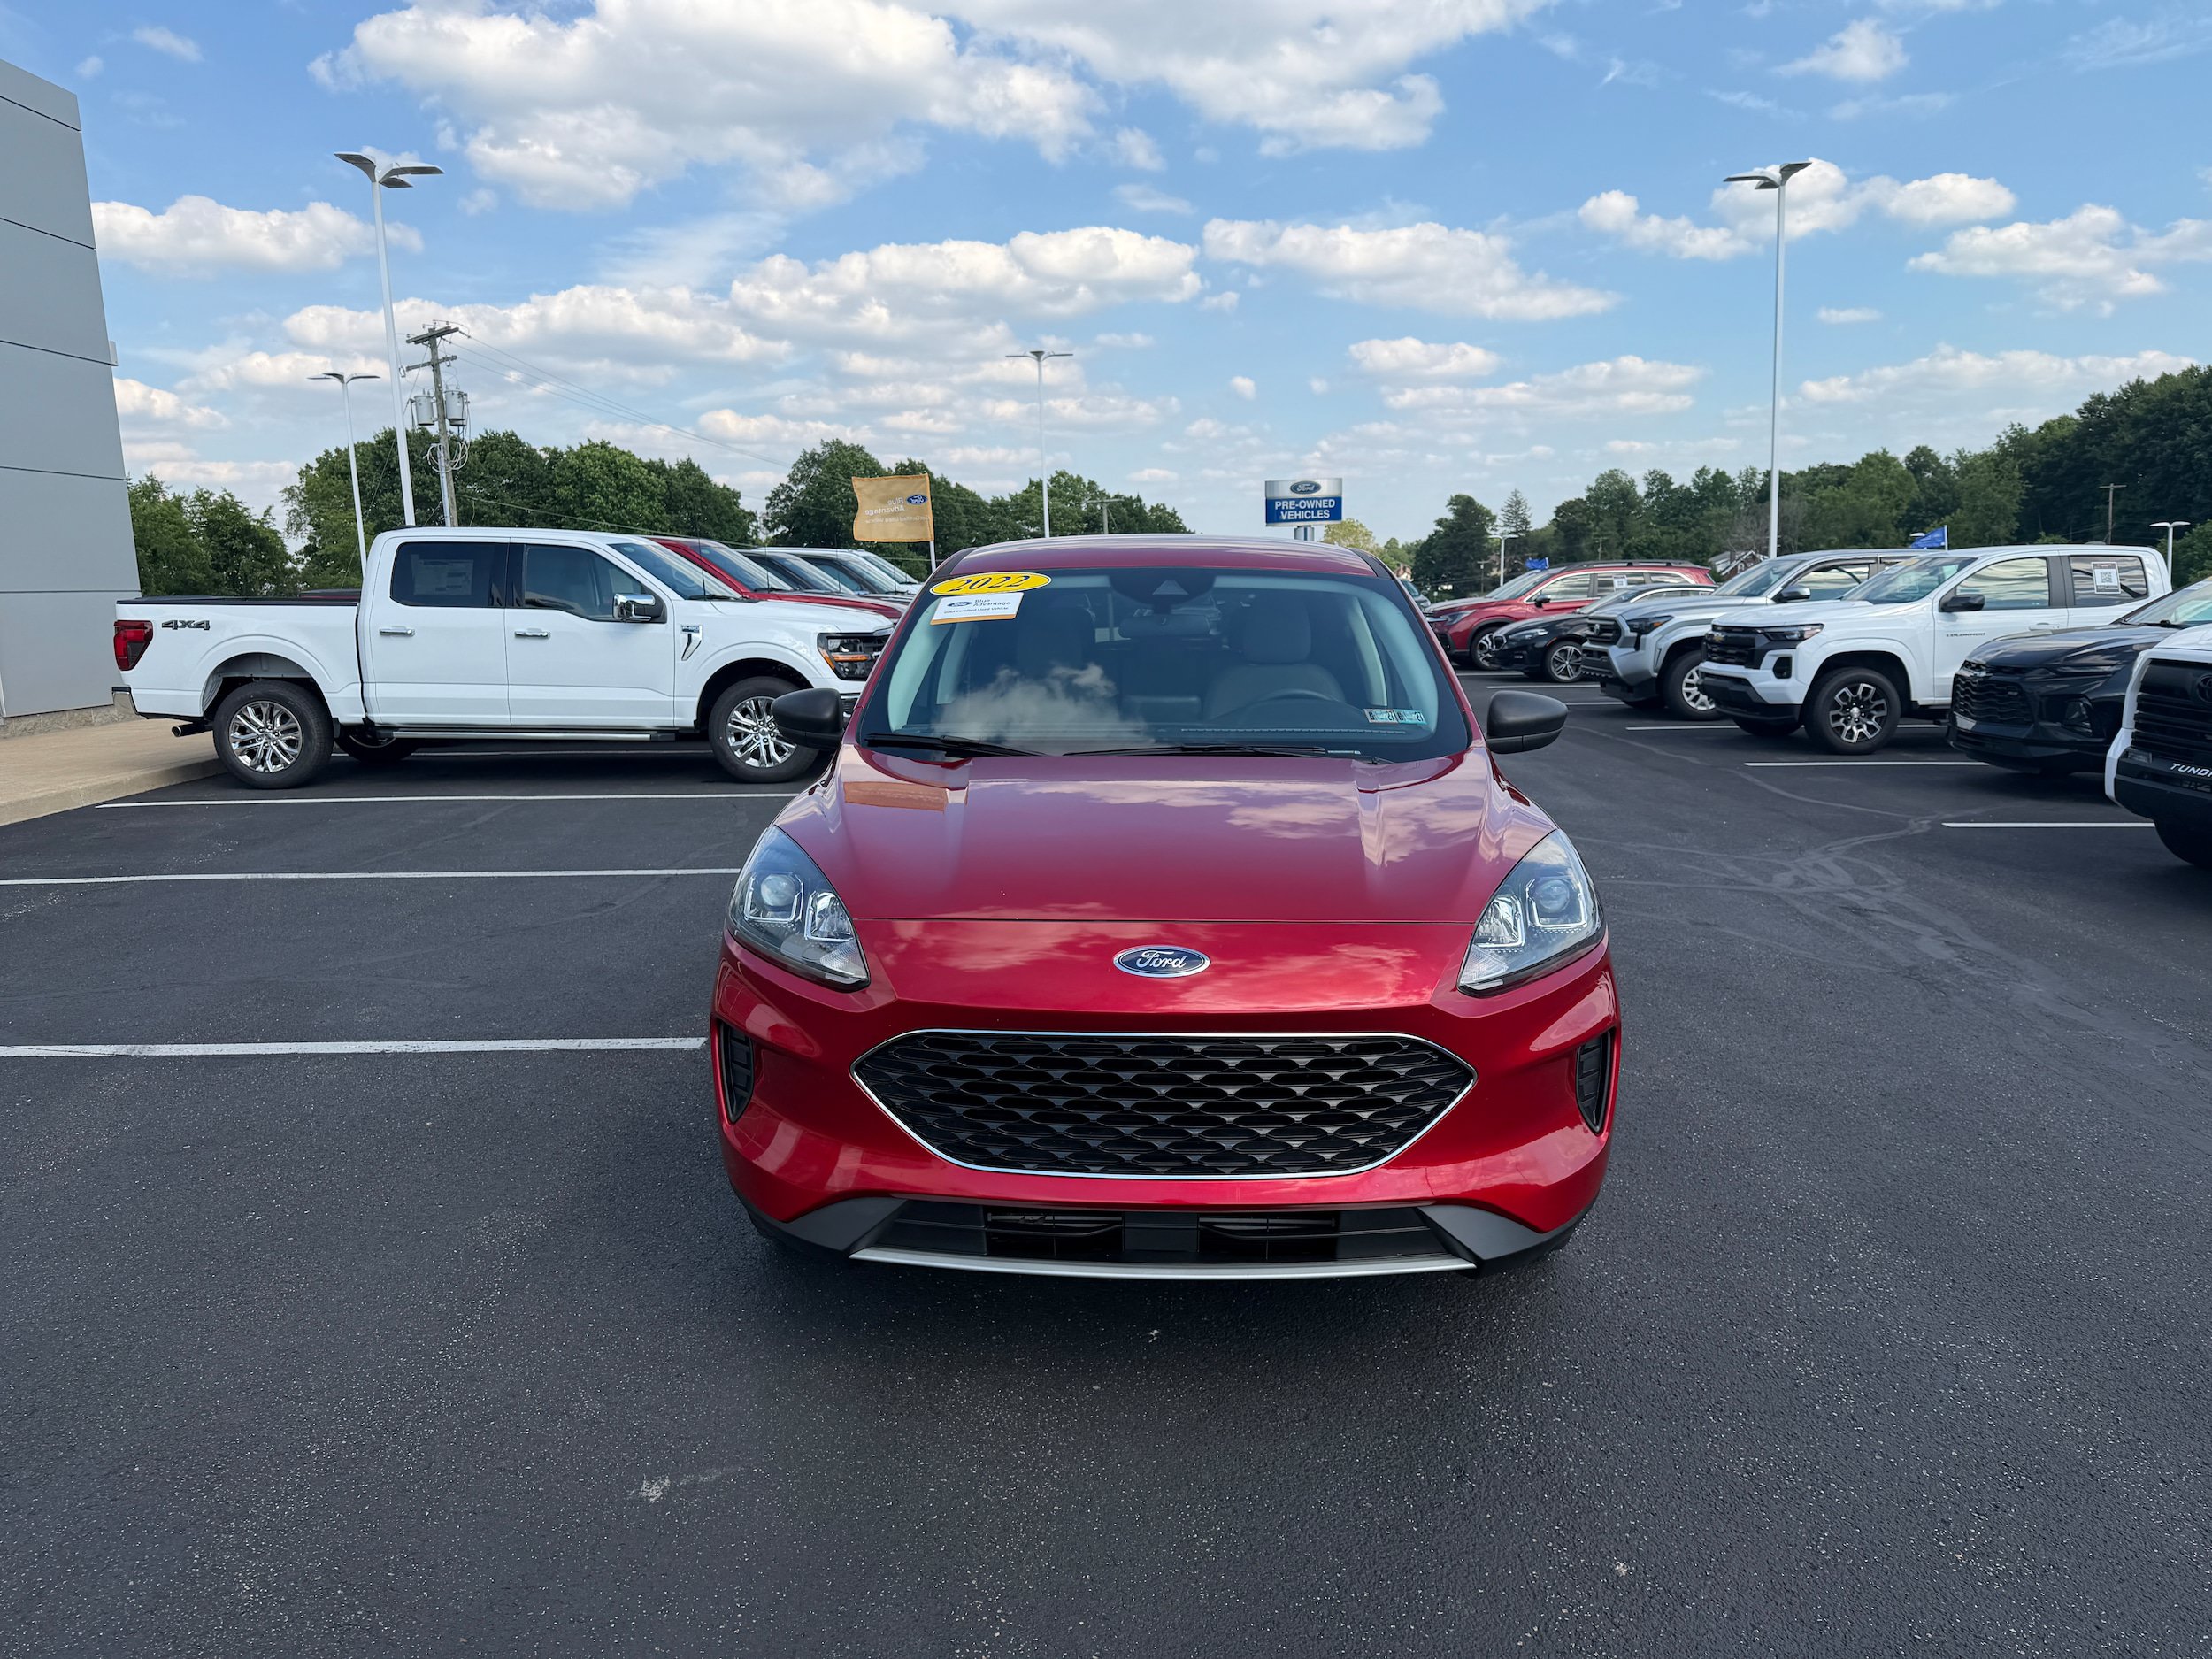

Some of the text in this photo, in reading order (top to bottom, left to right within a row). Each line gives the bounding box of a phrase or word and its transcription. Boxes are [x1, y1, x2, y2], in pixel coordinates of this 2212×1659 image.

[1296, 483, 1315, 492] Ford
[1274, 498, 1335, 510] PRE-OWNED
[1280, 510, 1330, 520] VEHICLES
[948, 575, 1031, 592] 2022
[1136, 949, 1187, 969] Ford
